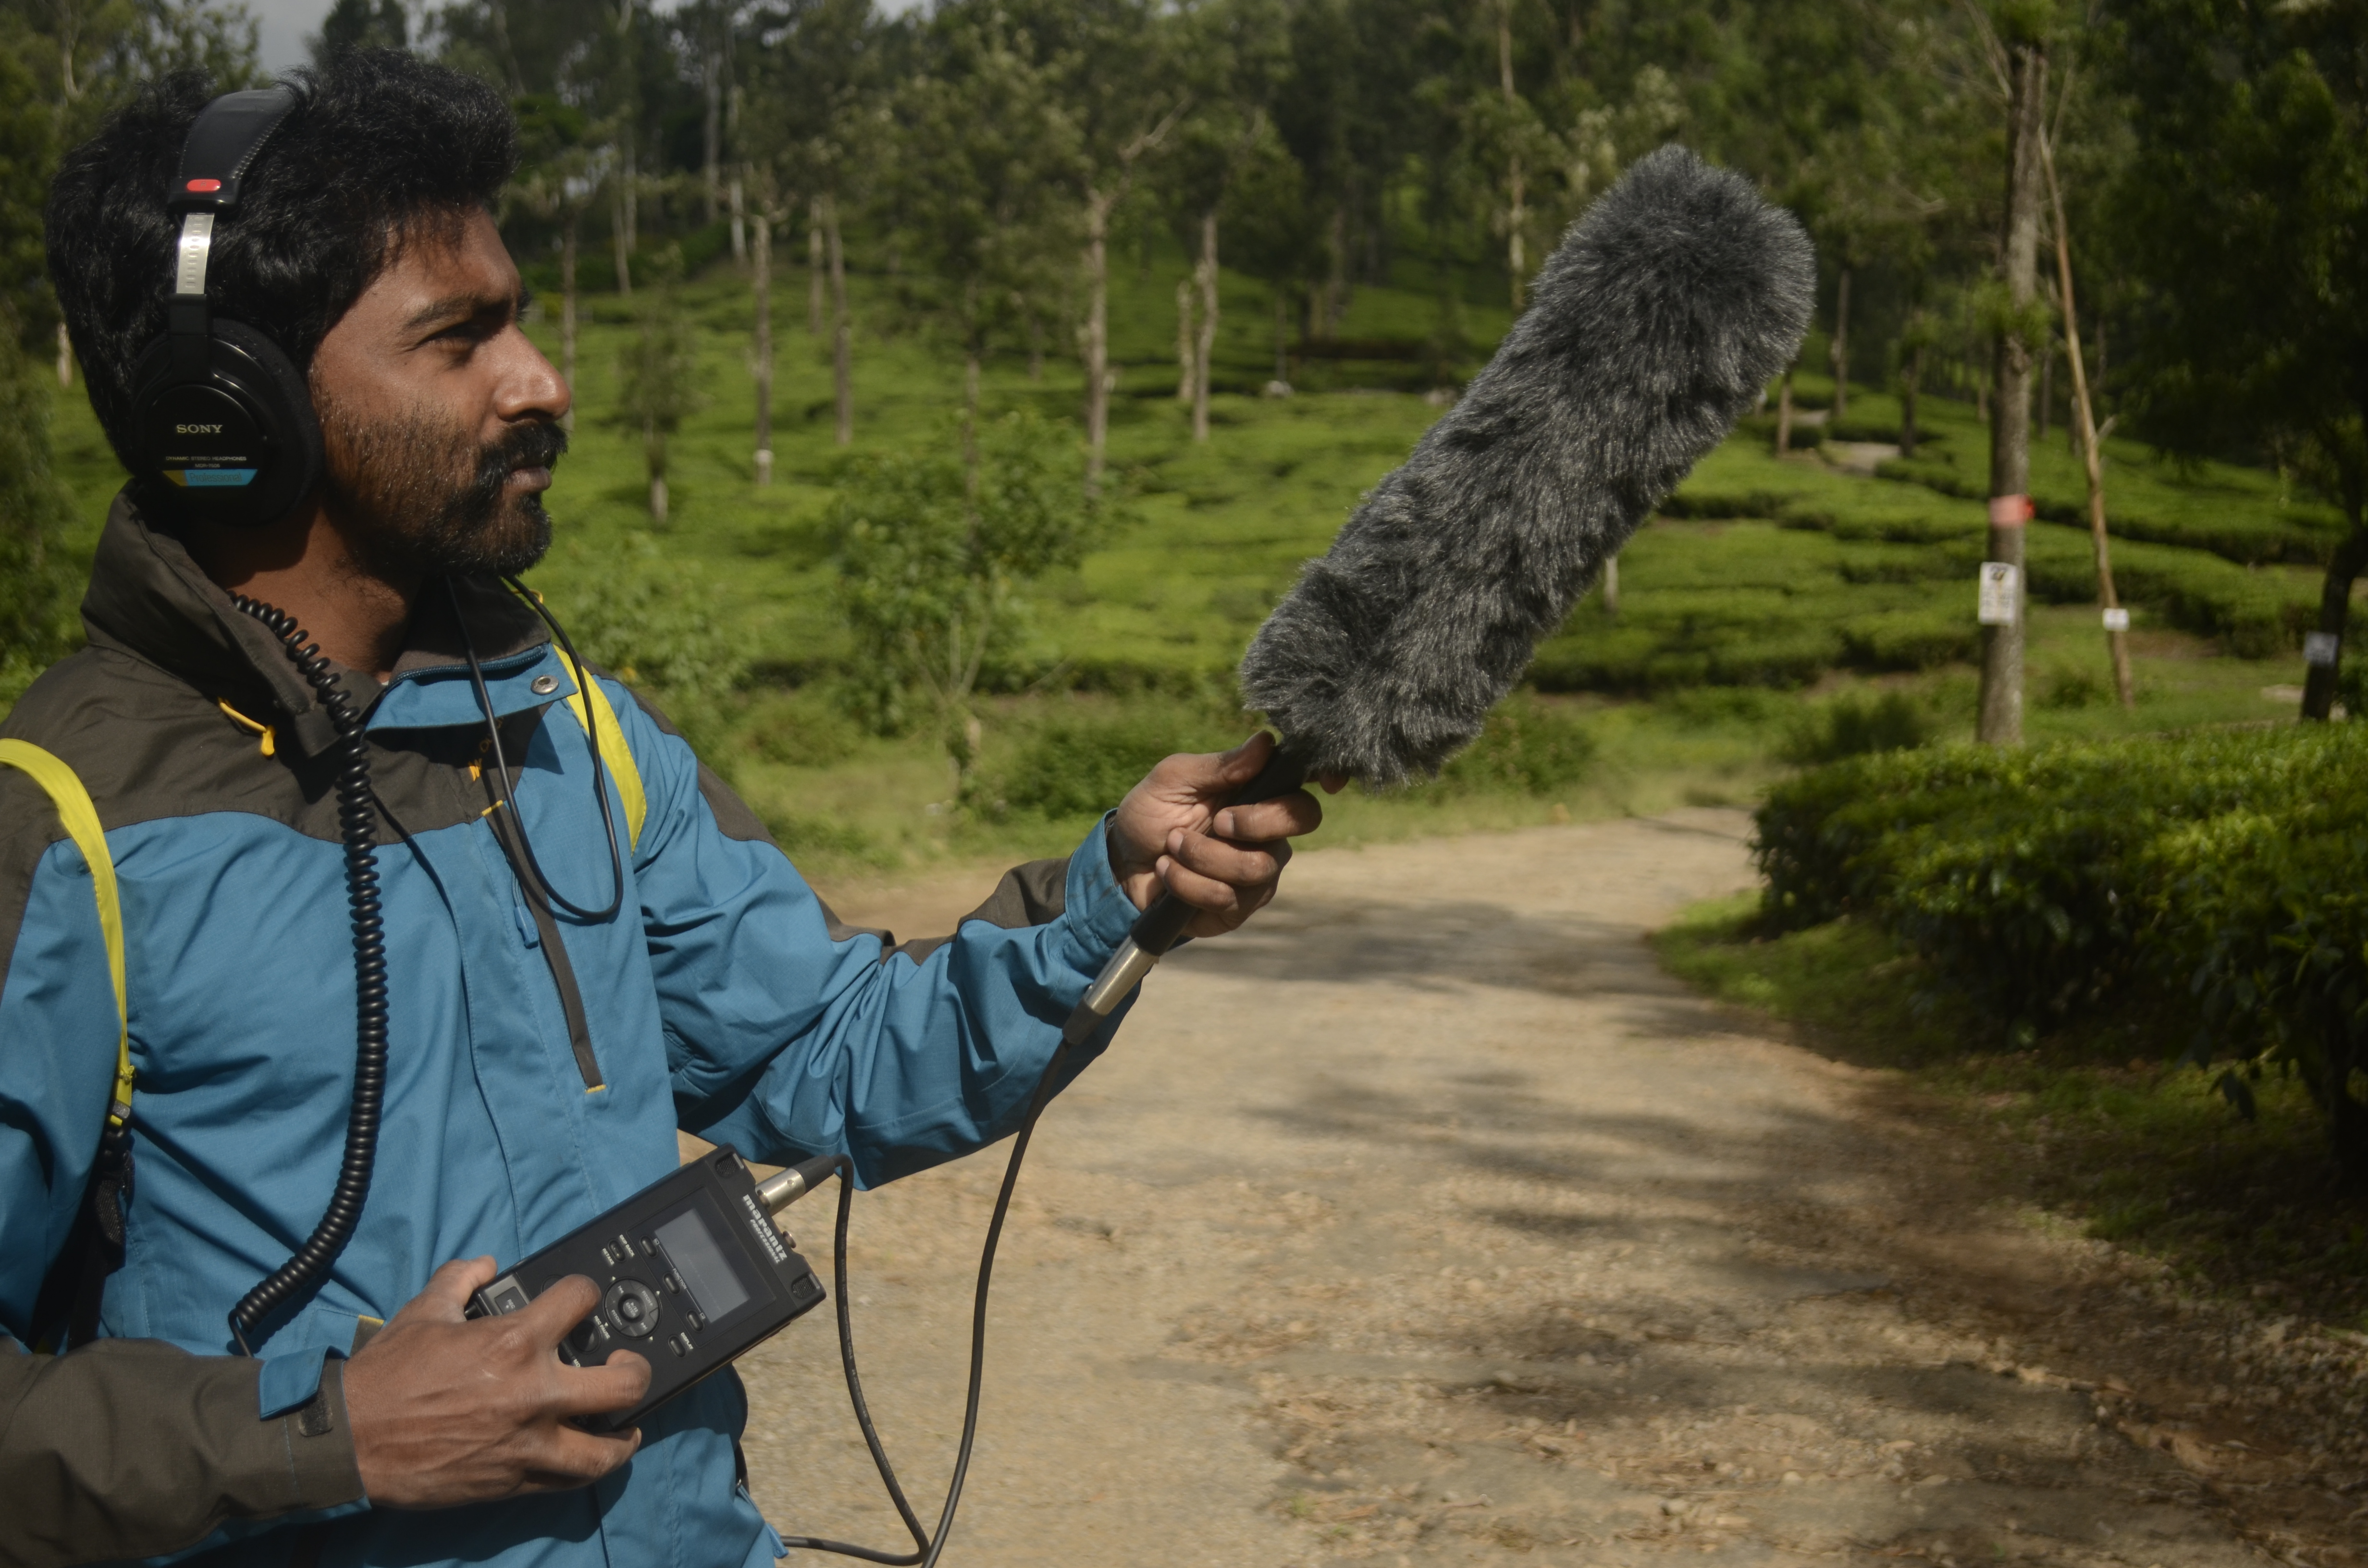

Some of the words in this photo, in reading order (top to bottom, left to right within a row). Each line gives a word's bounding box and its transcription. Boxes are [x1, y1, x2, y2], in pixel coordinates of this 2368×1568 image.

[176, 424, 222, 433] SONY
[189, 472, 242, 482] Professional
[743, 1194, 787, 1260] marantz
[750, 1219, 780, 1263] PROFESSIONAL
[602, 1248, 615, 1265] RETAKE
[625, 1244, 635, 1257] BACK
[673, 1268, 687, 1289] FUNCTION
[507, 1299, 516, 1309] REC
[626, 1302, 636, 1317] ENTER
[600, 1324, 610, 1339] PAUSE
[681, 1332, 693, 1349] DISPLAY
